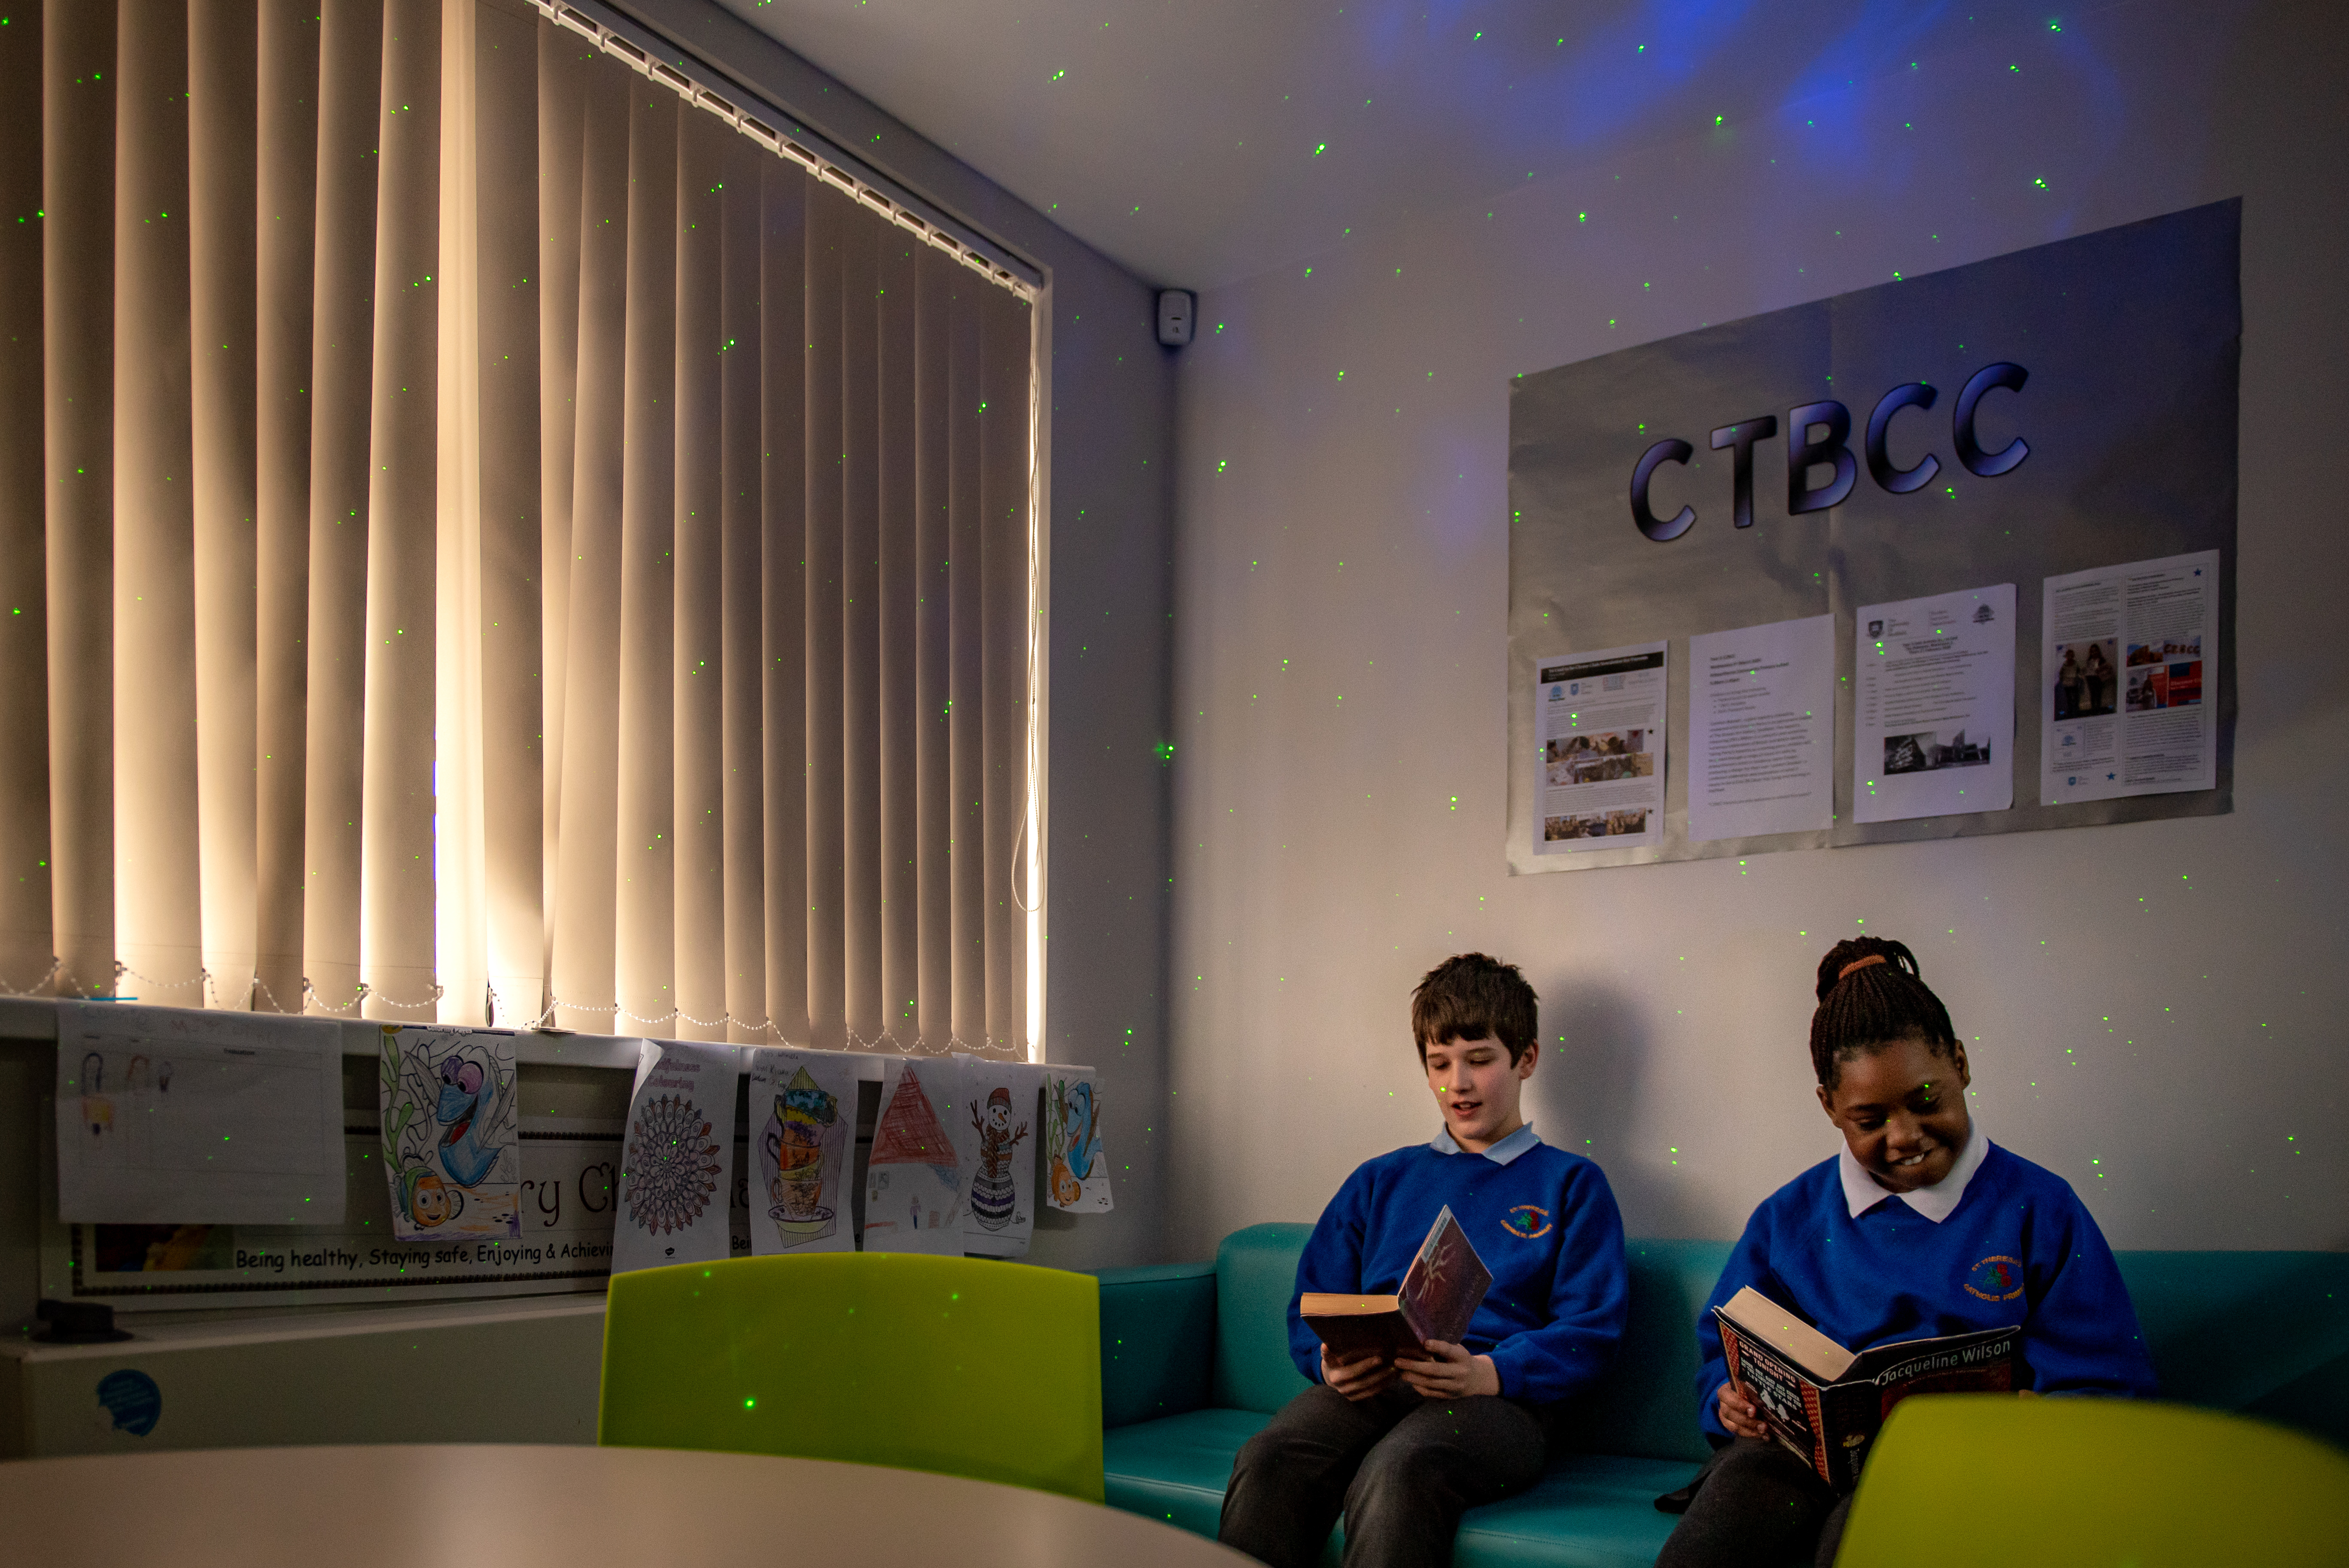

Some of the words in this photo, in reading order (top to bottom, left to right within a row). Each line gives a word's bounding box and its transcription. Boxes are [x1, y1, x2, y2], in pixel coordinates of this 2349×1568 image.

[1630, 362, 2030, 542] CTBCC
[647, 1075, 694, 1093] Colouring
[236, 1249, 284, 1273] Being
[290, 1248, 364, 1270] healthy,
[369, 1247, 430, 1269] Staying
[435, 1246, 473, 1264] safe,
[477, 1243, 542, 1265] Enjoying
[545, 1244, 556, 1259] &
[732, 1235, 752, 1249] Bei
[1739, 1340, 1763, 1361] GRAND
[1764, 1357, 1796, 1383] OPENING
[1753, 1357, 1784, 1382] TONIGHT
[1881, 1353, 1959, 1386] Jacqueline
[1962, 1340, 2011, 1363] Wilson
[1747, 1370, 1772, 1393] LITTLE
[1773, 1390, 1798, 1410] STARS
